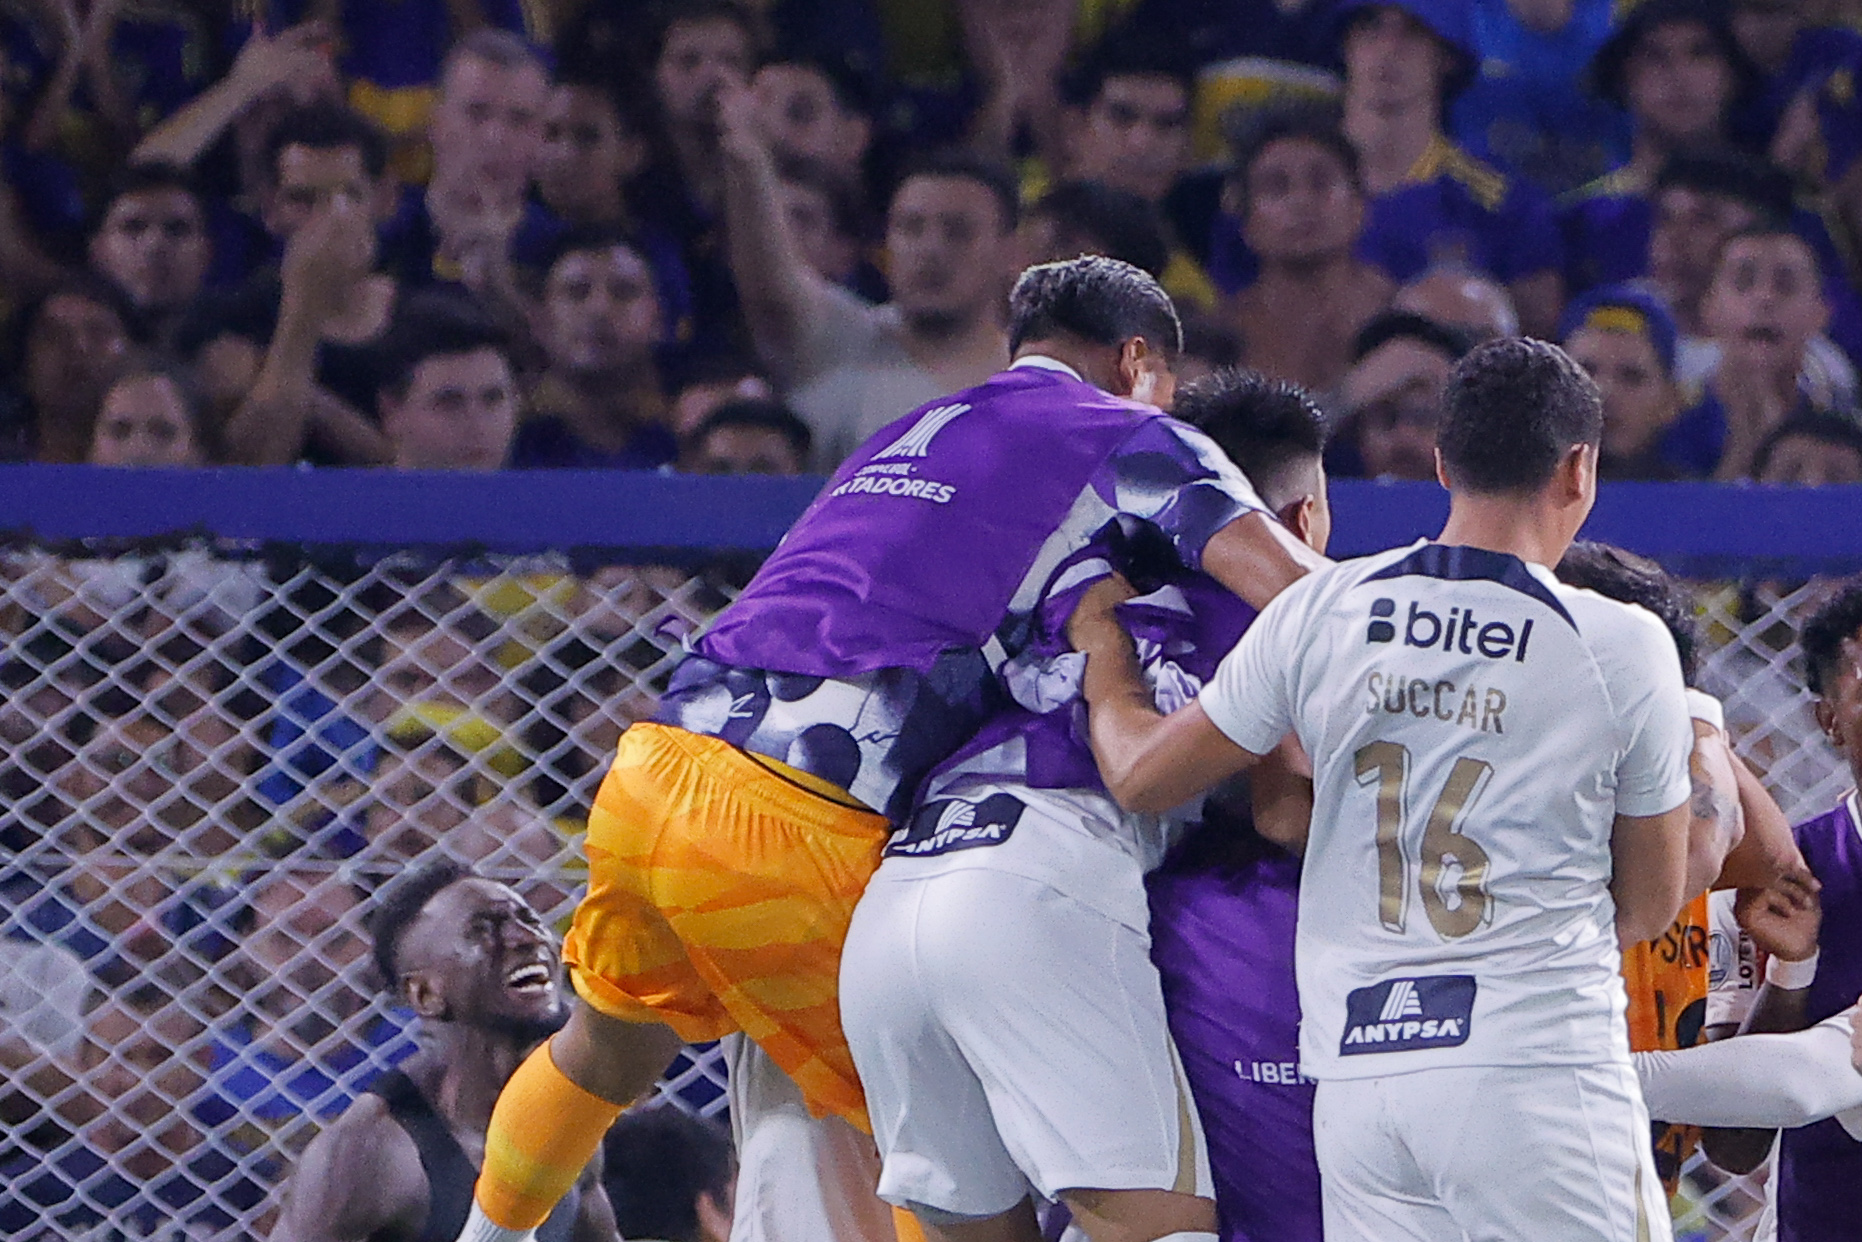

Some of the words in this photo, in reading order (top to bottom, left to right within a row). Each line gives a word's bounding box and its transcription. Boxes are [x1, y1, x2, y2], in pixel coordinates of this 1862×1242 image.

[1404, 601, 1534, 663] bitel
[1366, 671, 1507, 734] SUCCAR
[1354, 740, 1495, 943] 16
[1345, 1019, 1461, 1045] ANYPSA
